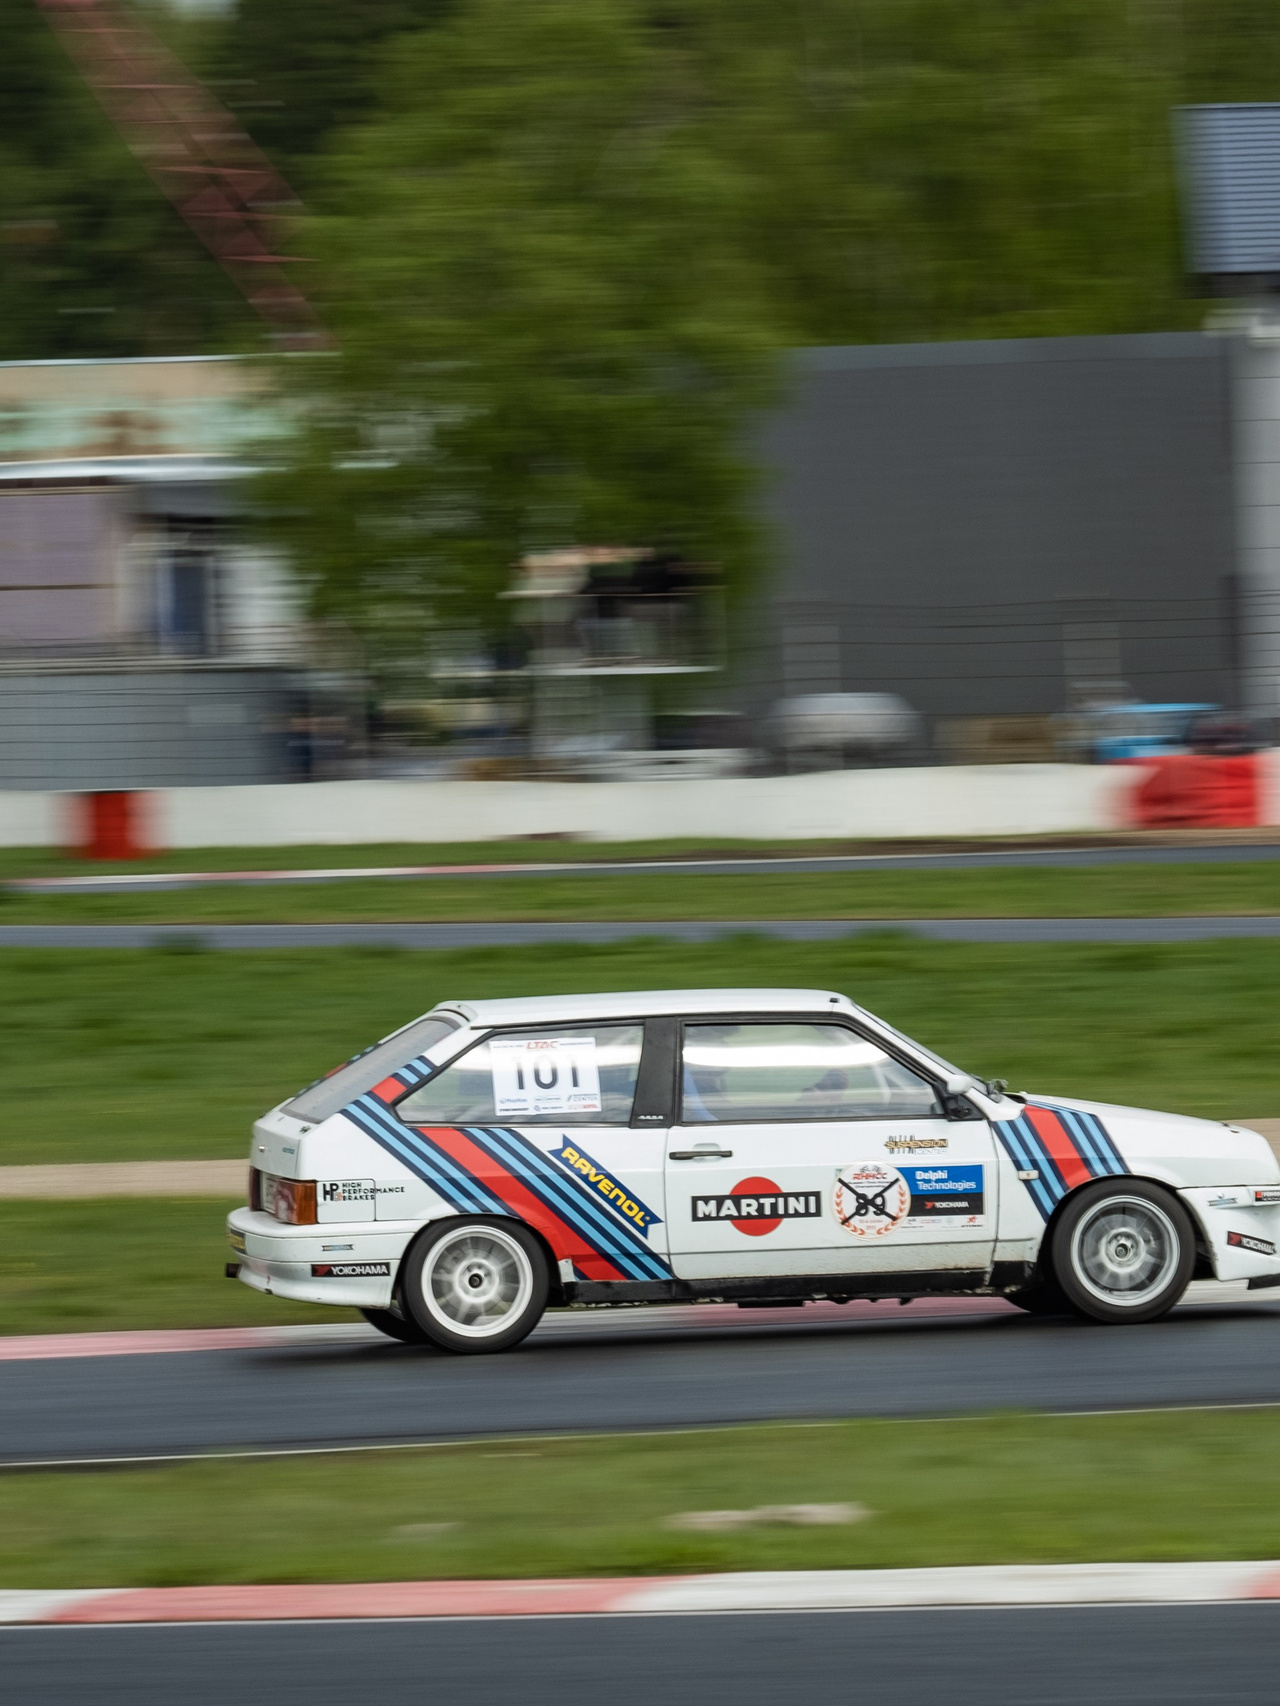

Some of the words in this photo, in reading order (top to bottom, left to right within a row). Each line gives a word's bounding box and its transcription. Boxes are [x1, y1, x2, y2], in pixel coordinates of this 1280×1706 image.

[915, 1170, 948, 1181] Delphi
[342, 1187, 405, 1195] PERFORMANCE
[561, 1147, 646, 1227] RAVENOL
[916, 1180, 976, 1191] Technologies
[696, 1196, 817, 1218] MARTINI
[934, 1201, 969, 1209] YOKOHAMA
[331, 1265, 389, 1275] YOKOHAMA
